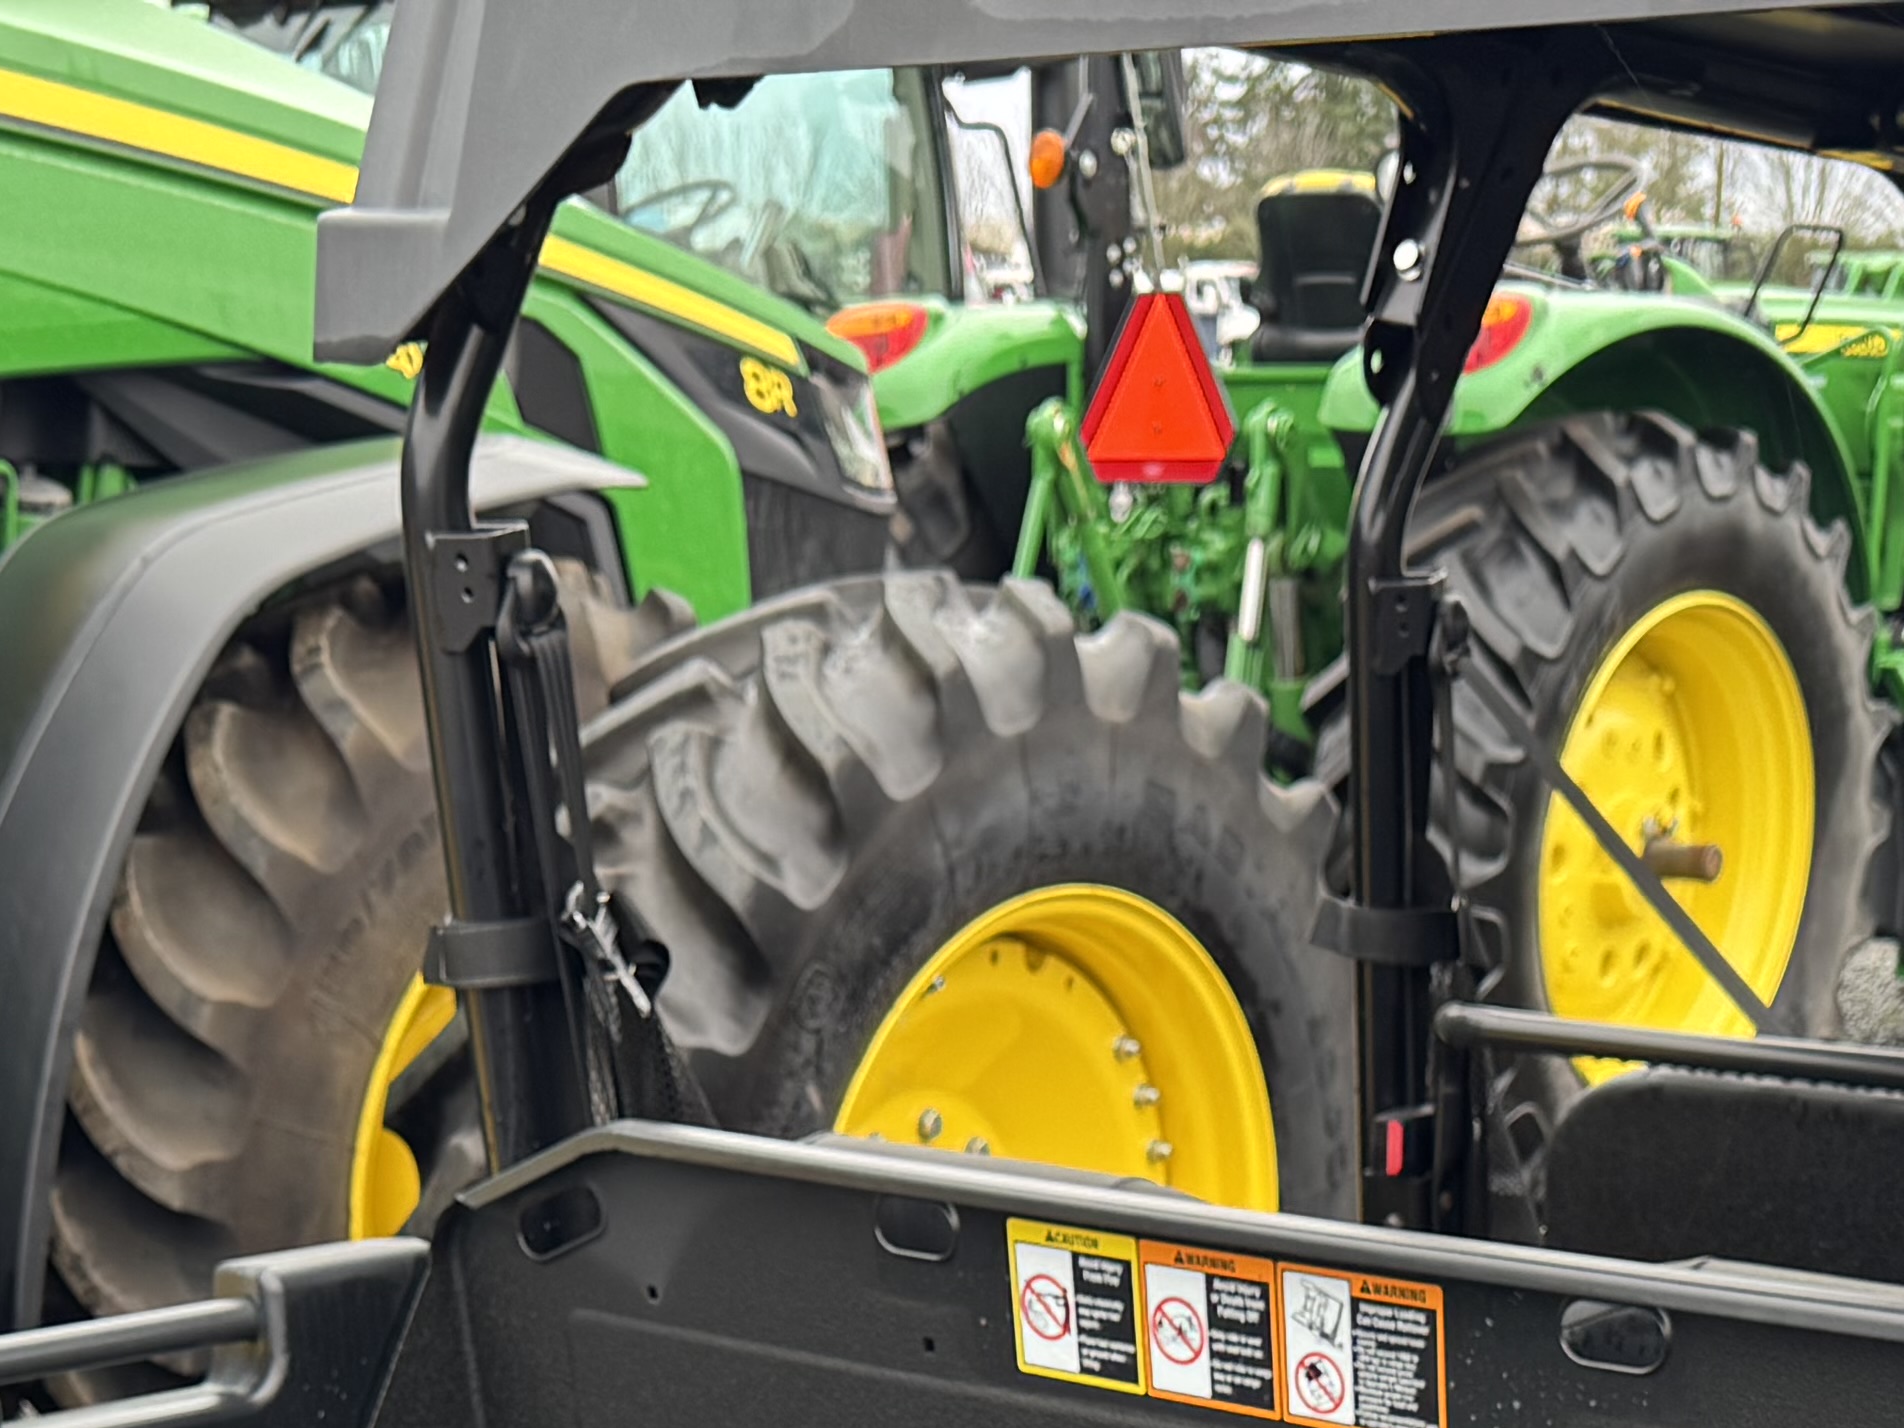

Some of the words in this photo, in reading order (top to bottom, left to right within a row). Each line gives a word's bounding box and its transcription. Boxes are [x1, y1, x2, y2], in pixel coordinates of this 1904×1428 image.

[1053, 1230, 1100, 1249] CAUTION
[1183, 1252, 1236, 1273] WARNING
[1372, 1282, 1427, 1304] WARNING
